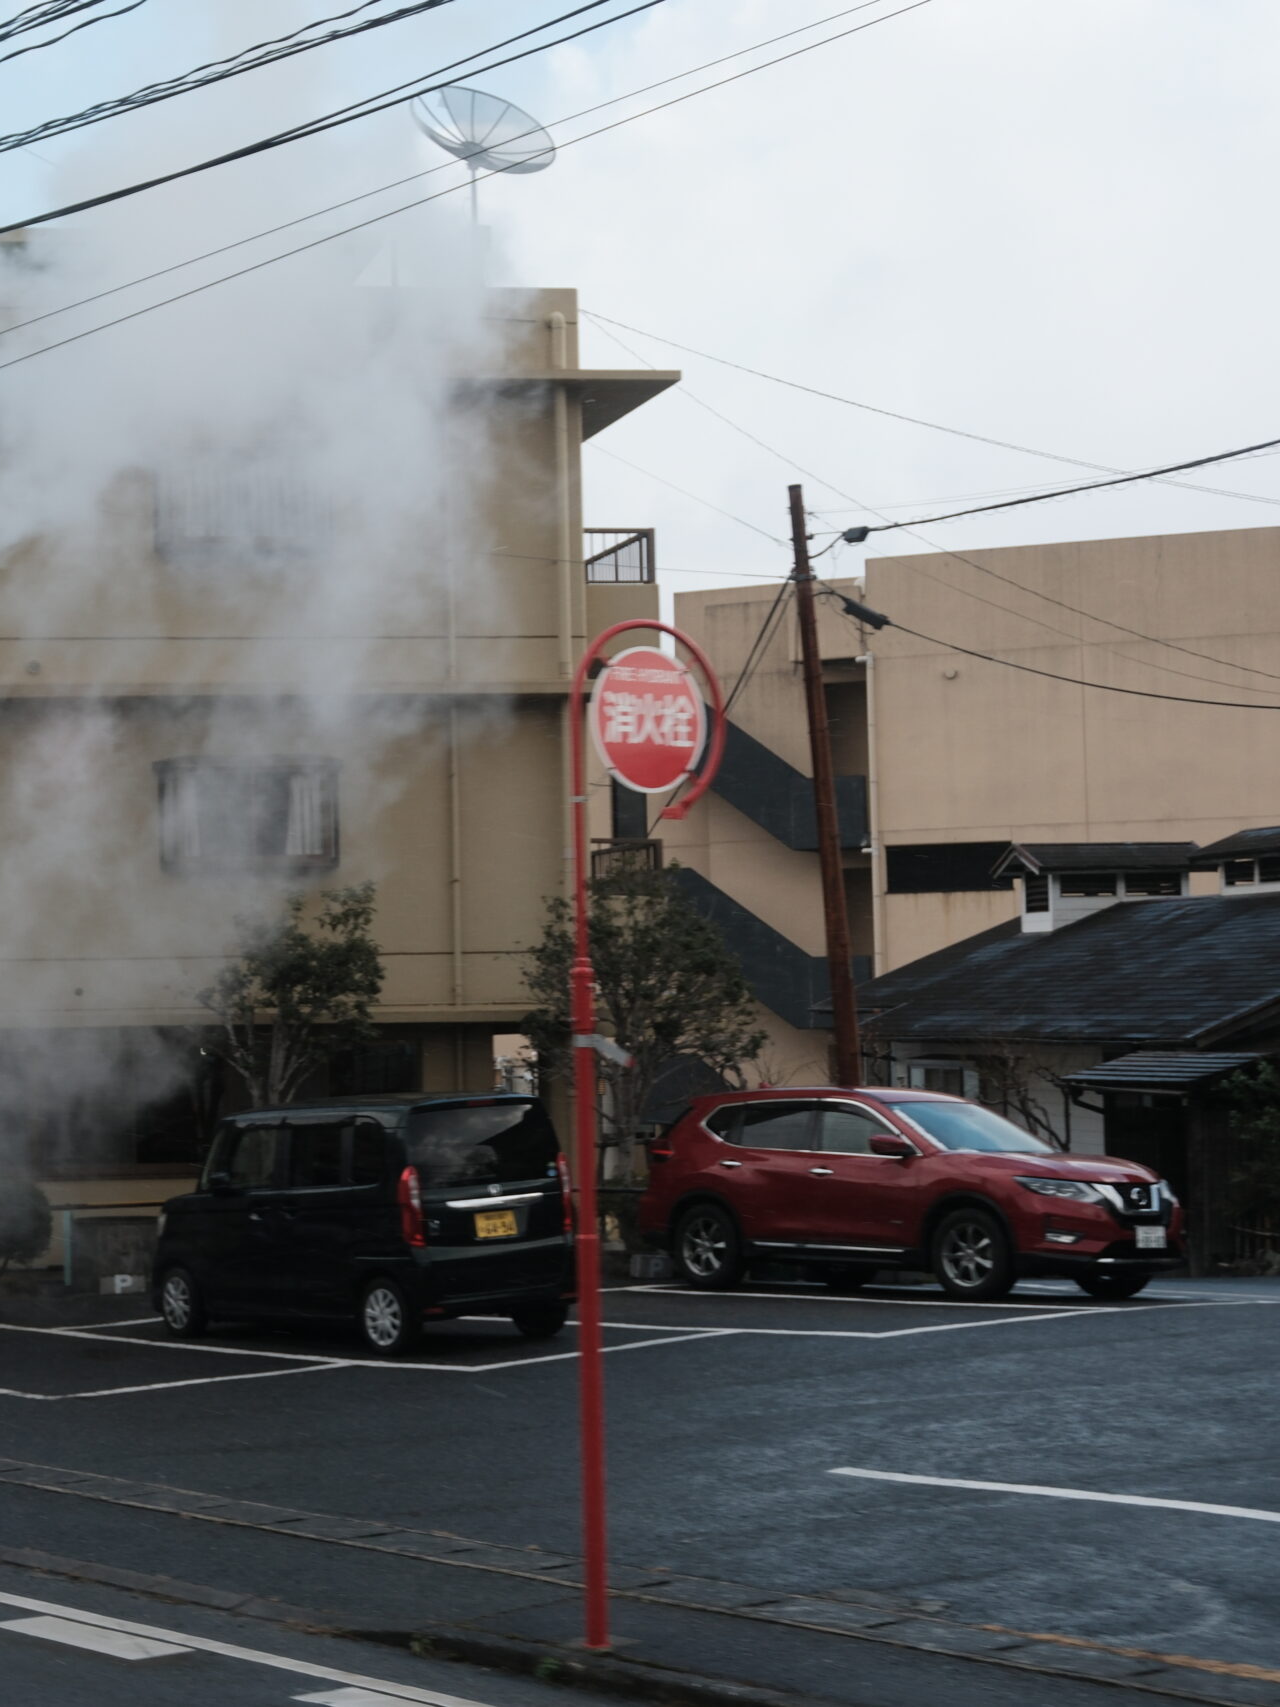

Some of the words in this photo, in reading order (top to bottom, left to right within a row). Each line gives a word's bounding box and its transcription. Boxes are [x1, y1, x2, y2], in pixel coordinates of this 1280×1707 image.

[602, 690, 695, 748] 消火栓
[114, 1274, 132, 1294] P
